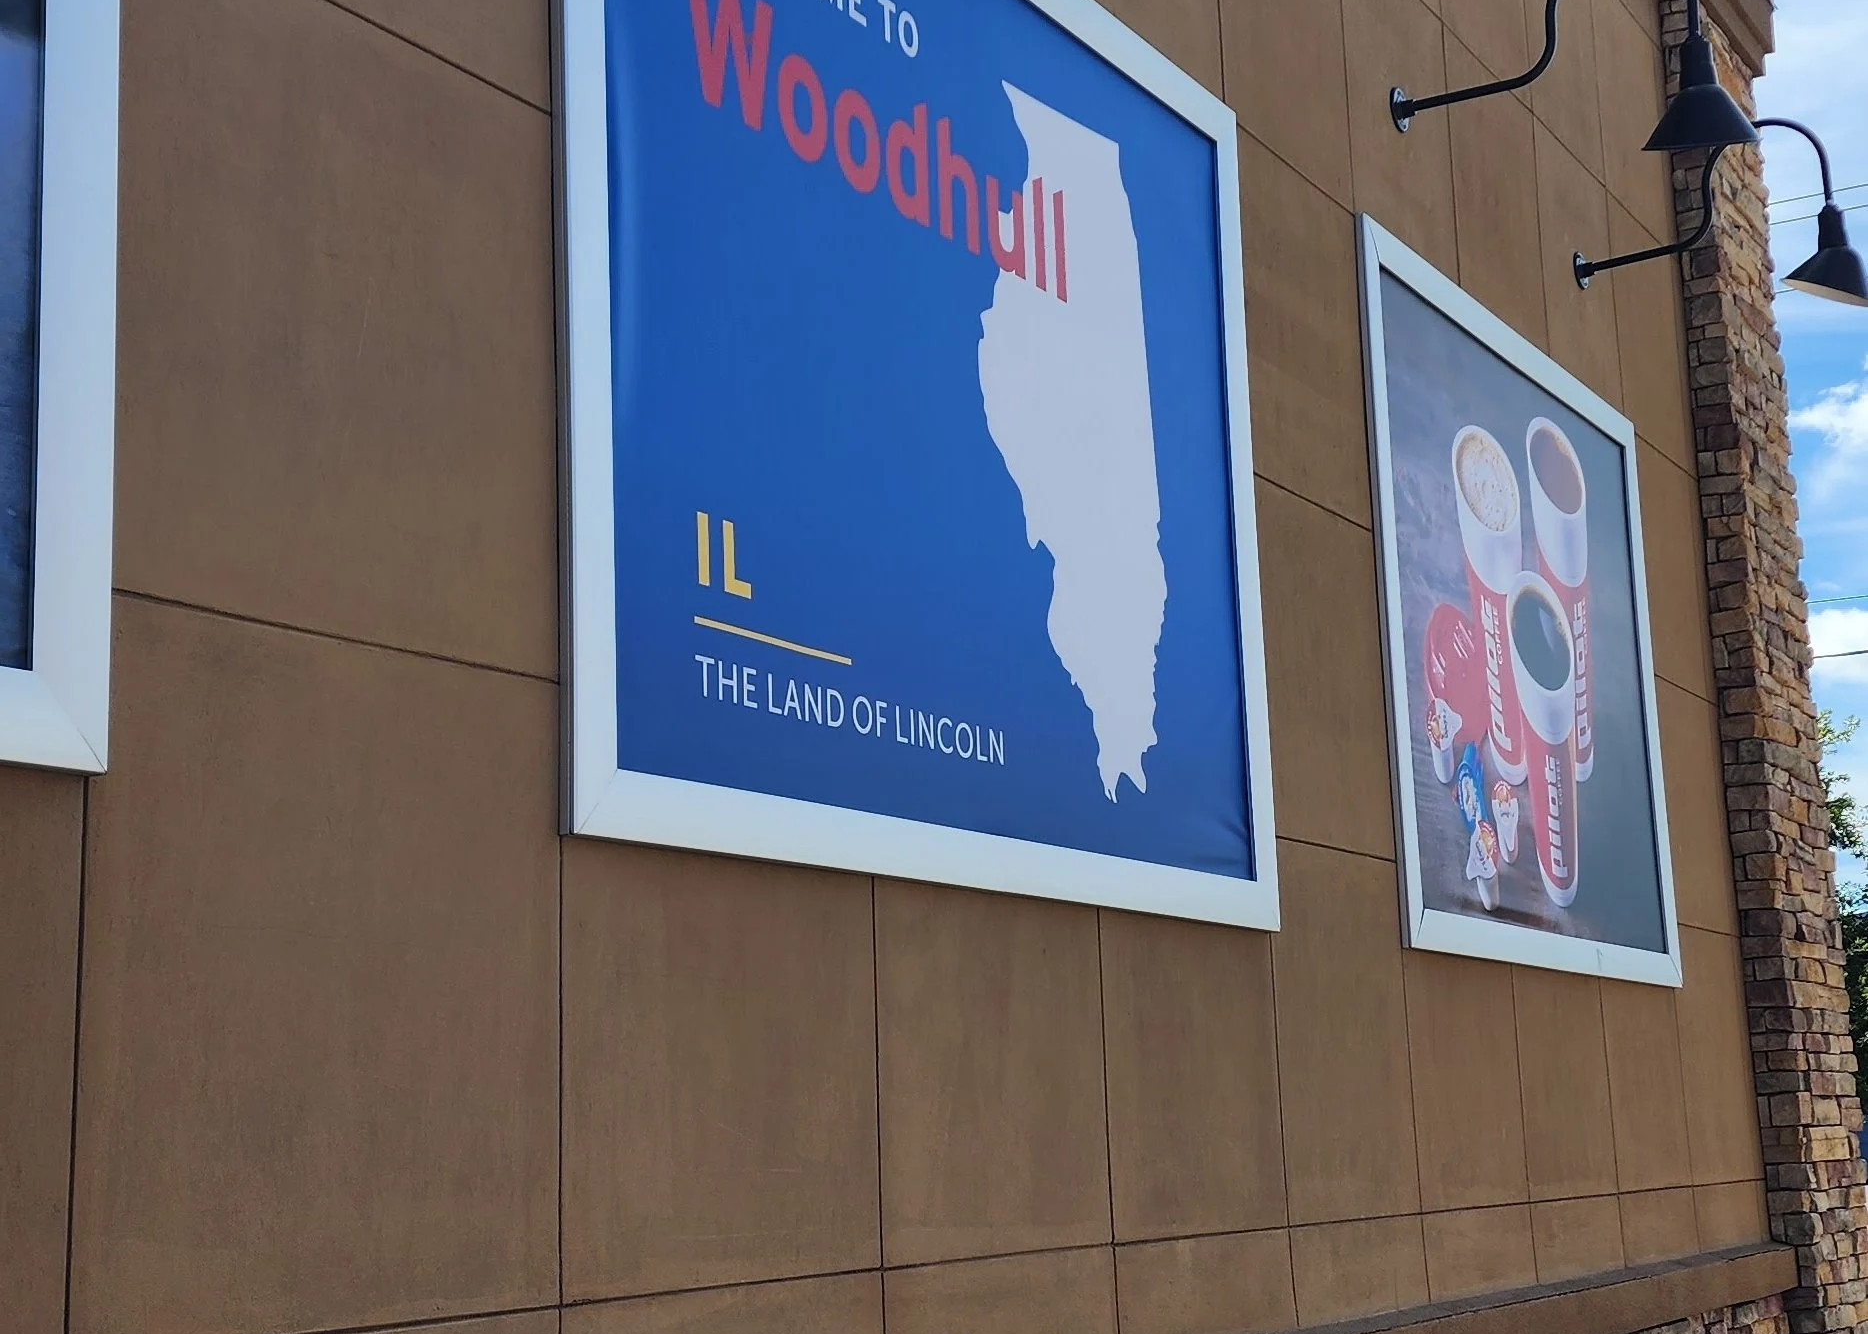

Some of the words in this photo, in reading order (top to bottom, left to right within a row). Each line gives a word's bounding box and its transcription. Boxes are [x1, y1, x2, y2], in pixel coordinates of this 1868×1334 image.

[697, 511, 752, 599] IL
[695, 654, 758, 709] THE
[767, 673, 845, 728] LAND
[852, 695, 888, 738] OF
[895, 705, 1005, 766] LINCOLN
